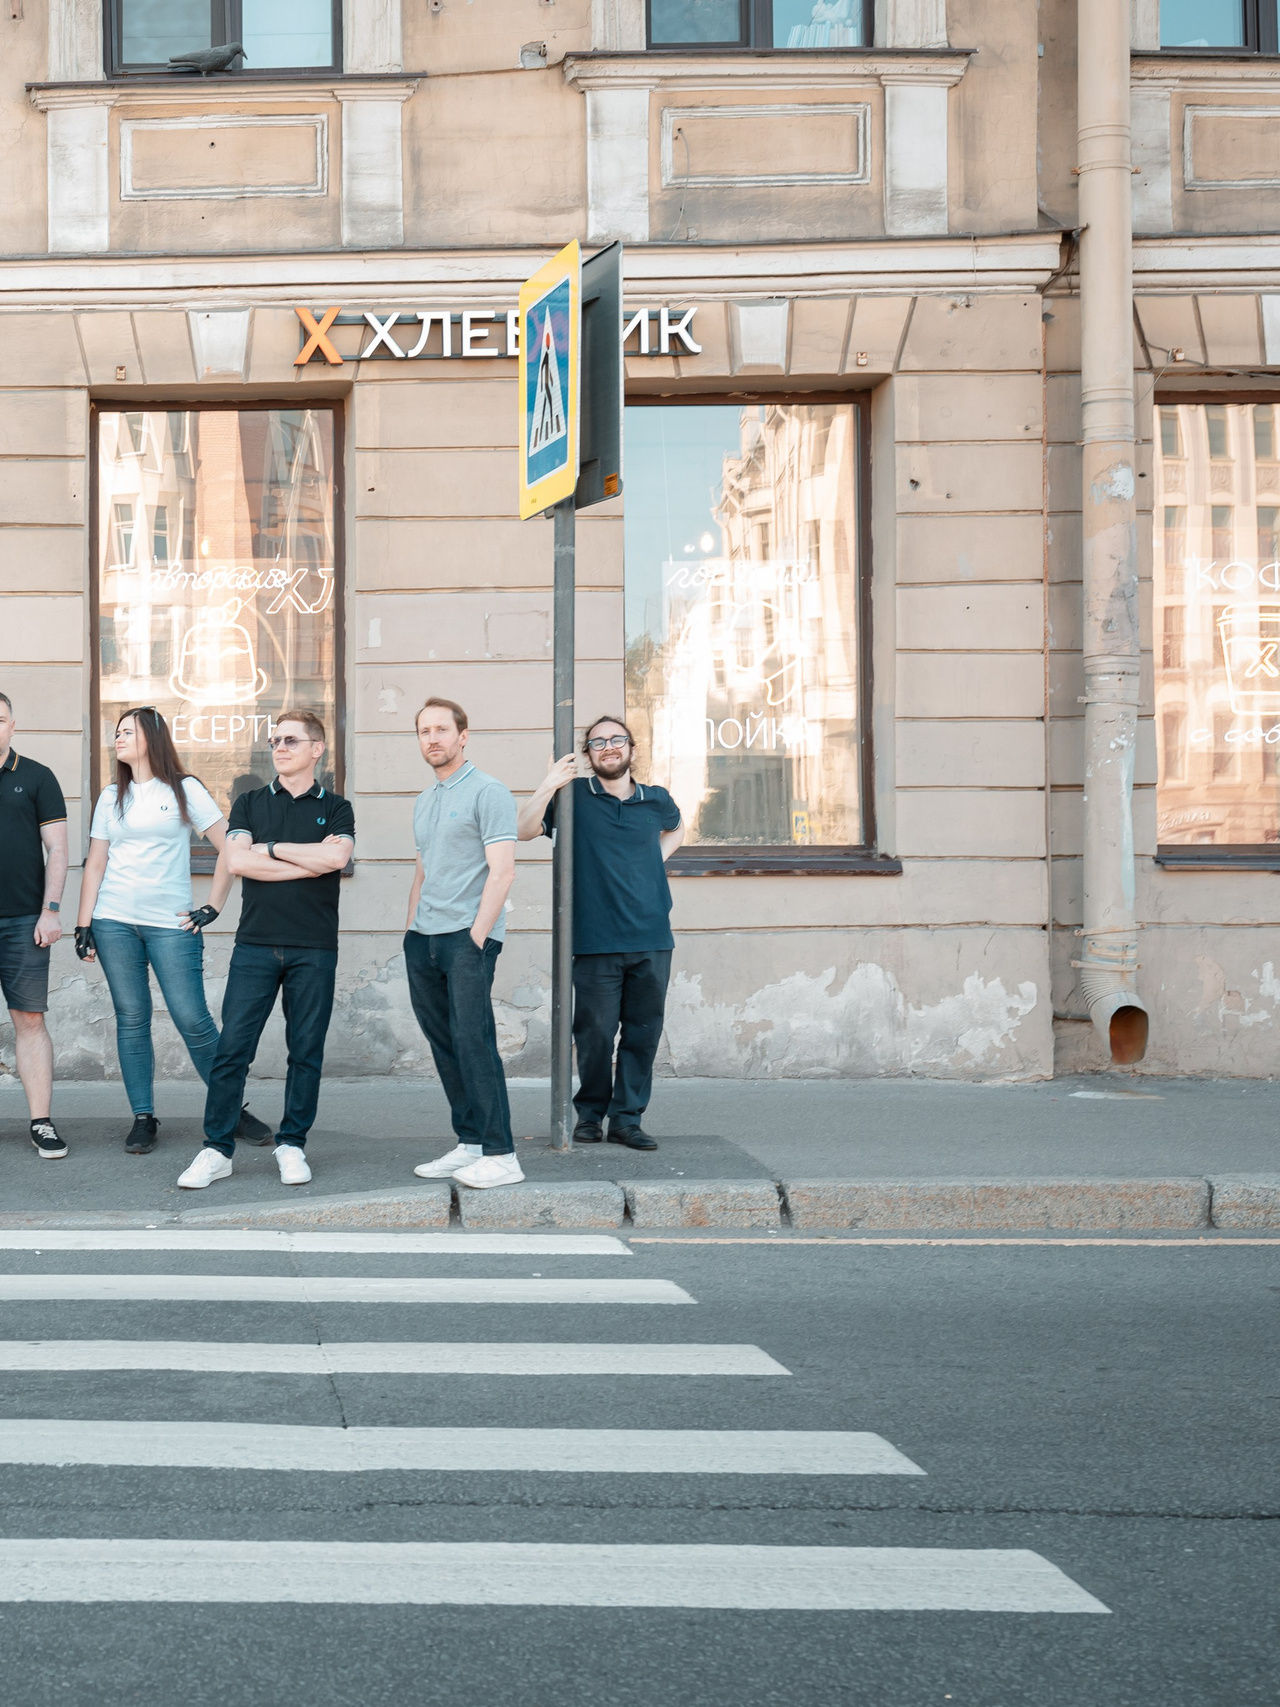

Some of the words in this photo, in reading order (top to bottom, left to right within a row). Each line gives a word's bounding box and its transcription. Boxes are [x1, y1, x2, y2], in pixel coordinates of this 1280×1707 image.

[294, 307, 344, 366] Х
[360, 307, 702, 359] ХЛЕИК
[163, 714, 277, 744] ЕСЕРТ
